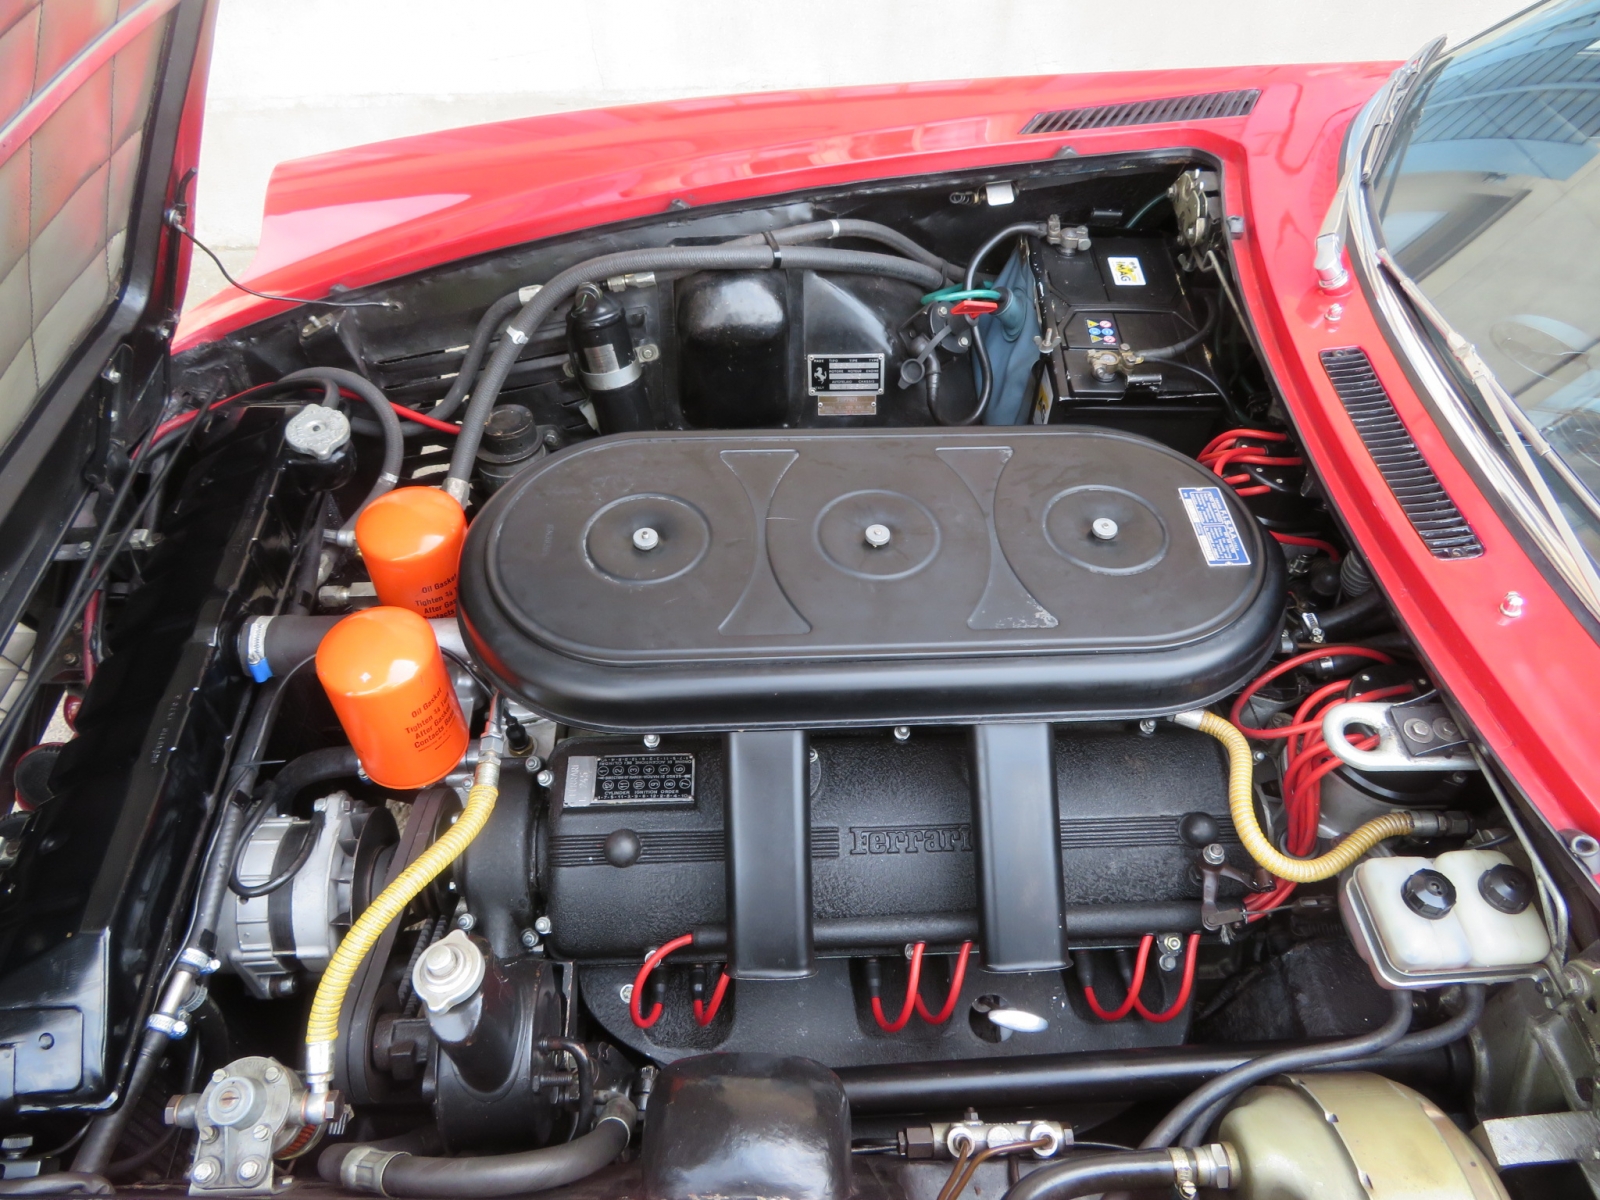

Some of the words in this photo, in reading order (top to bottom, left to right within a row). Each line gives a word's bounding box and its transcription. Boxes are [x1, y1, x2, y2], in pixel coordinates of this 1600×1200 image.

[415, 596, 443, 607] Tighten
[424, 605, 442, 614] After
[411, 708, 422, 718] Oil
[423, 687, 442, 710] Gasket
[405, 715, 433, 734] Tighten
[415, 725, 433, 739] After
[434, 703, 450, 726] Gasket
[414, 725, 444, 748] Contacts
[848, 823, 973, 855] Ferrari
